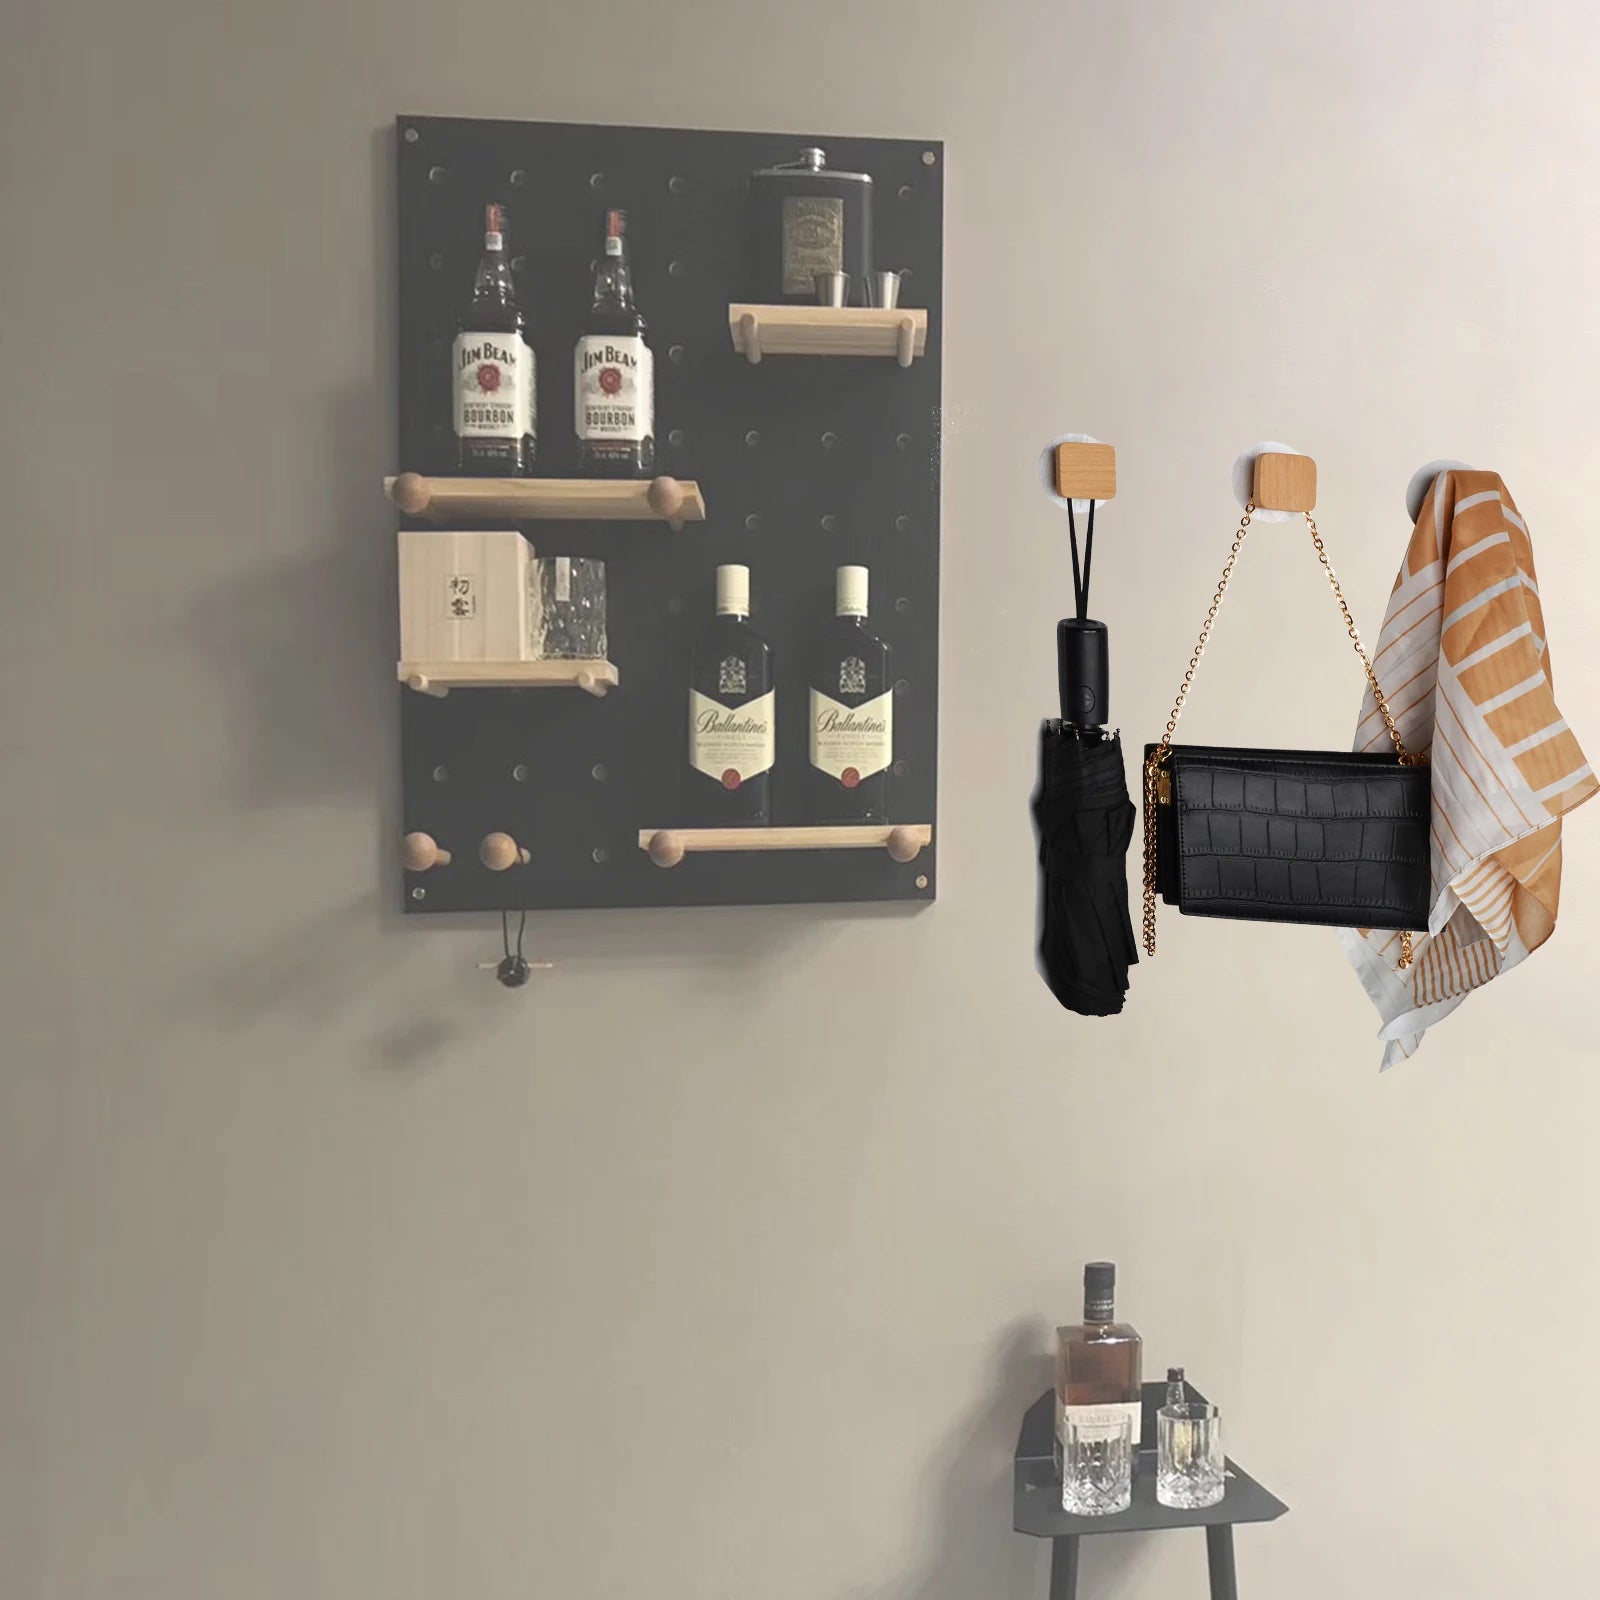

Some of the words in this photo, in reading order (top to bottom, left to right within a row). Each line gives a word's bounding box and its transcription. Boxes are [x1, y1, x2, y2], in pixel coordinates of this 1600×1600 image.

[459, 347, 481, 370] JIM
[580, 350, 602, 373] JIM
[463, 409, 514, 423] BOURBON
[585, 411, 635, 426] BOURBON
